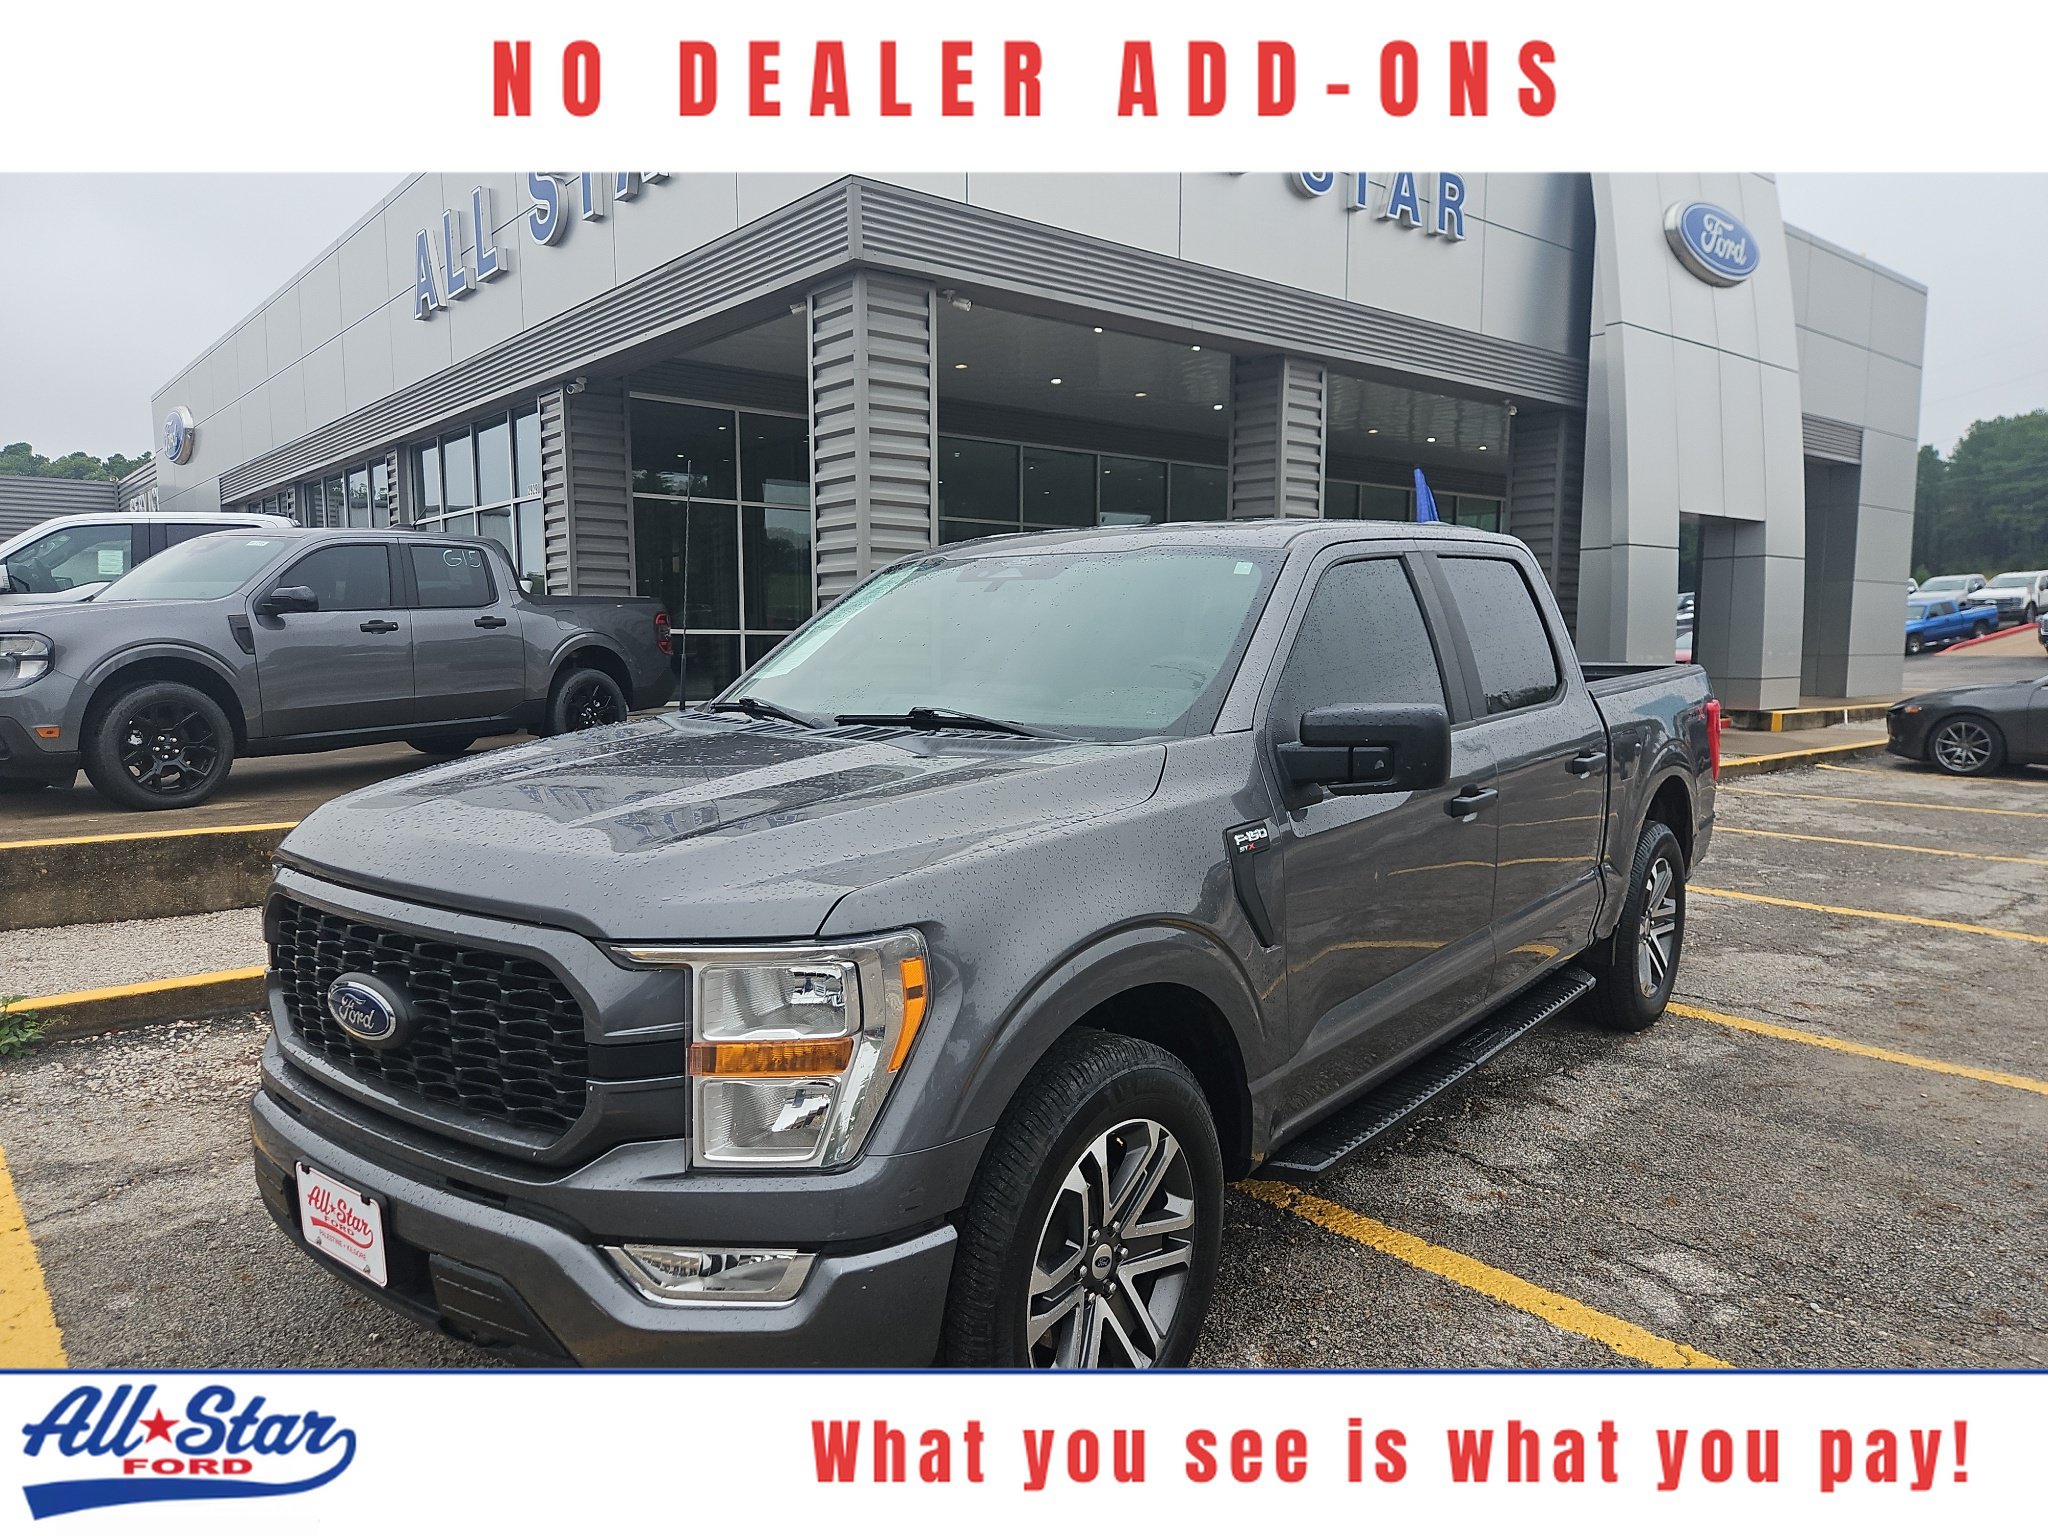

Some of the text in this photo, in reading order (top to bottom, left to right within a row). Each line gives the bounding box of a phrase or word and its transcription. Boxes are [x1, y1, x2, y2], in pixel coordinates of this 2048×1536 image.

[414, 186, 507, 320] ALL
[1701, 213, 1747, 266] Ford
[443, 550, 480, 567] G15
[1234, 828, 1268, 845] F-150
[339, 993, 376, 1030] Ford
[307, 1185, 373, 1236] All Star
[324, 1215, 355, 1236] FORD
